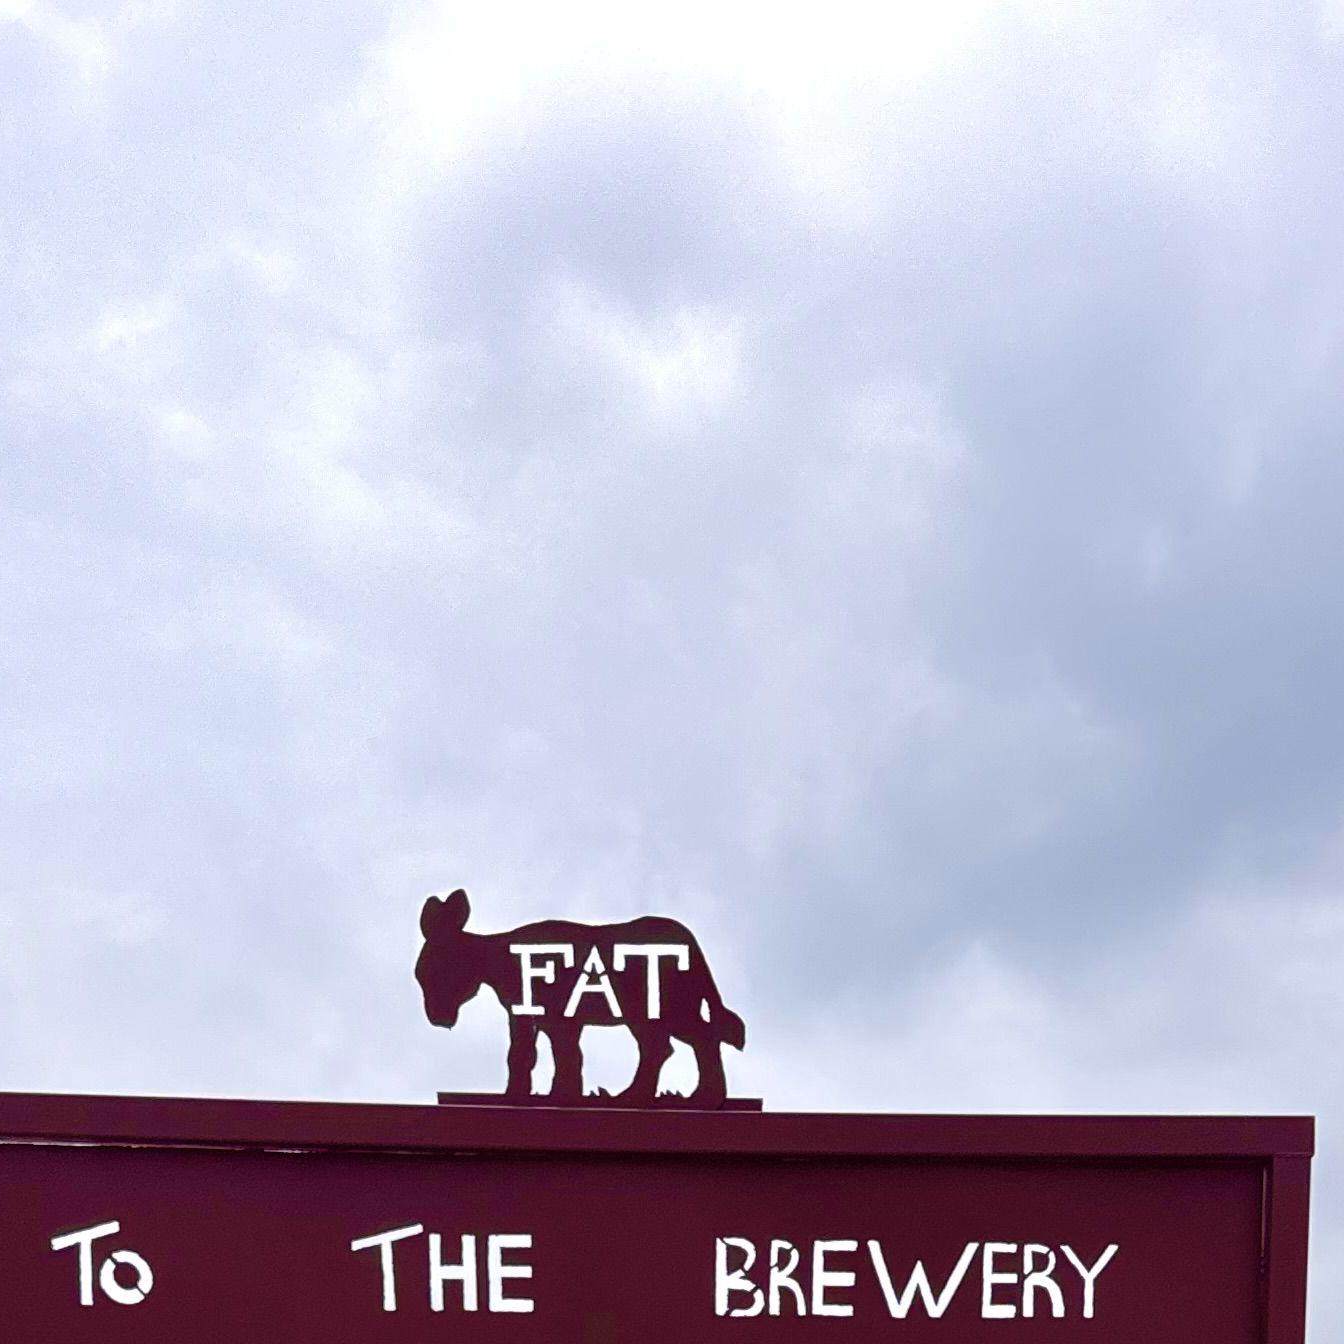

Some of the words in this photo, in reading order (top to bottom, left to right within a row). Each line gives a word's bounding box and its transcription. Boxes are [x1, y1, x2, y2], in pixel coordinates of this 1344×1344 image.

[510, 943, 690, 1019] FAT
[351, 1223, 535, 1314] THE
[715, 1237, 1119, 1319] BREWERY
